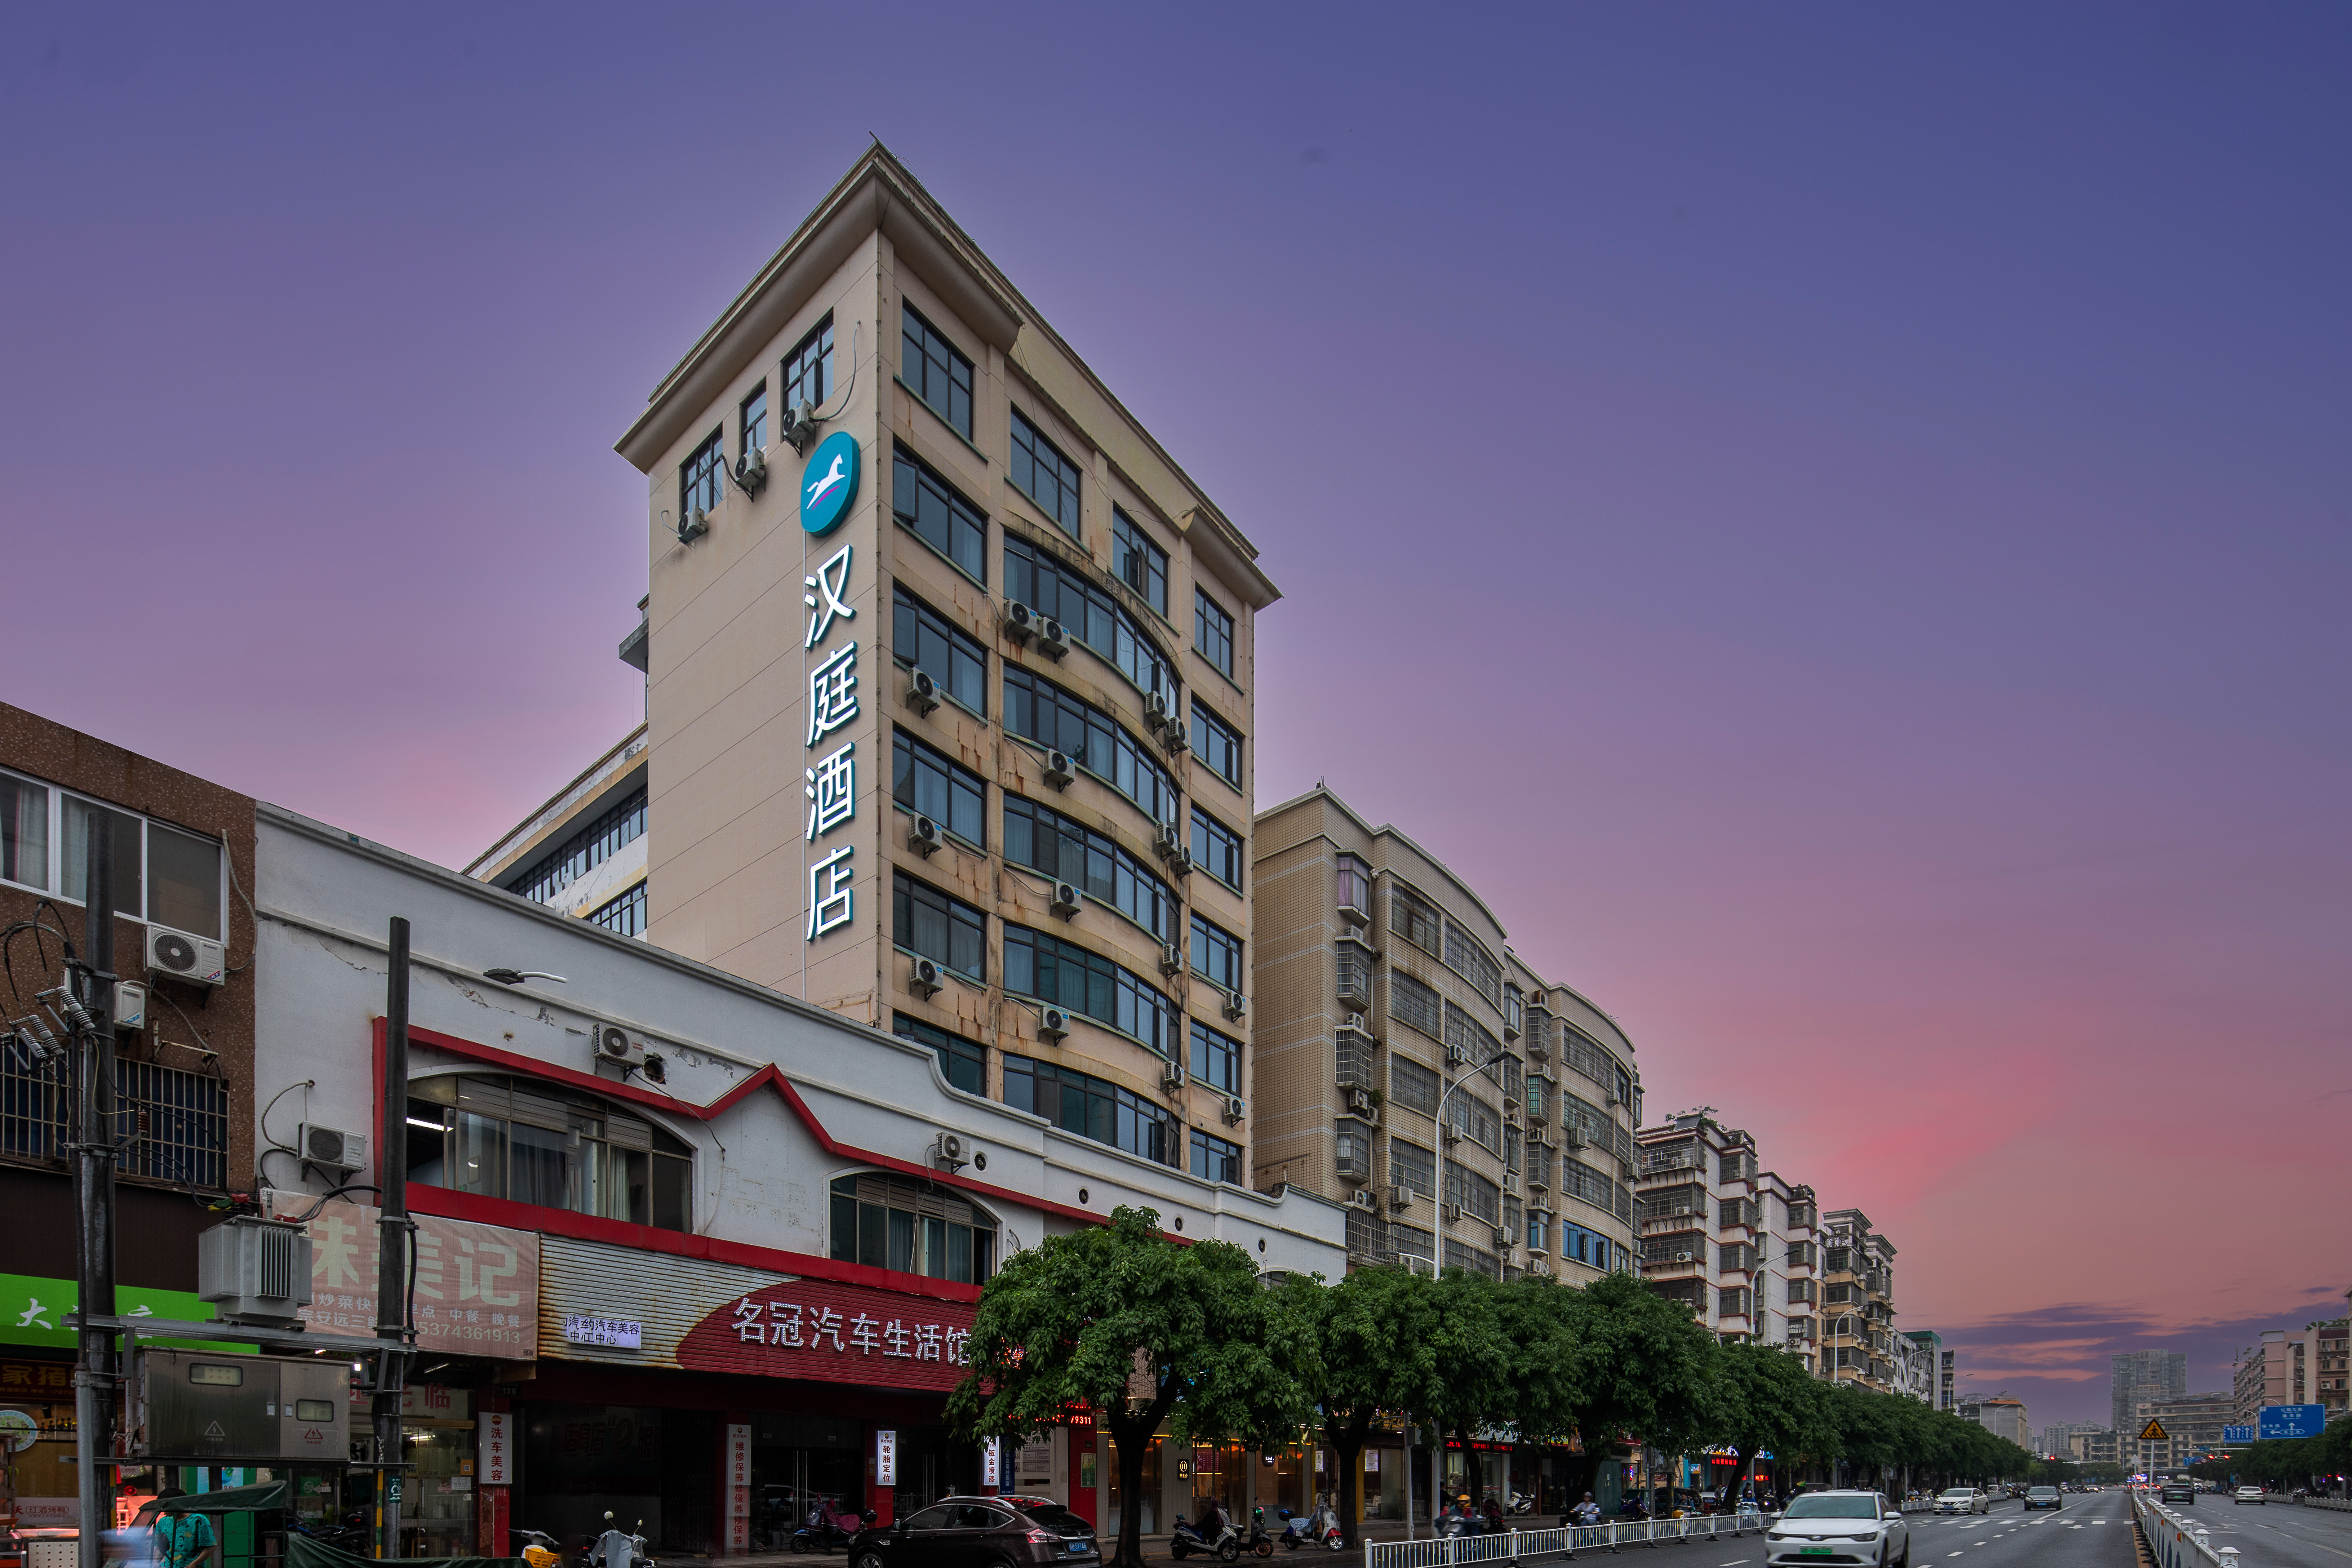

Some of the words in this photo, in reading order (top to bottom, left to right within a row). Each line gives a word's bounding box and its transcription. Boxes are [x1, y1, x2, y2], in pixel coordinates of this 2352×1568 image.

[805, 544, 860, 941] 汉庭酒店
[311, 1292, 378, 1311] 炒菜快
[450, 1309, 478, 1323] 中餐
[492, 1312, 520, 1328] 晚餐
[731, 1298, 972, 1366] 名冠汽车生活馆
[3, 1365, 75, 1386] 家猪
[491, 1427, 502, 1481] 洗车美容
